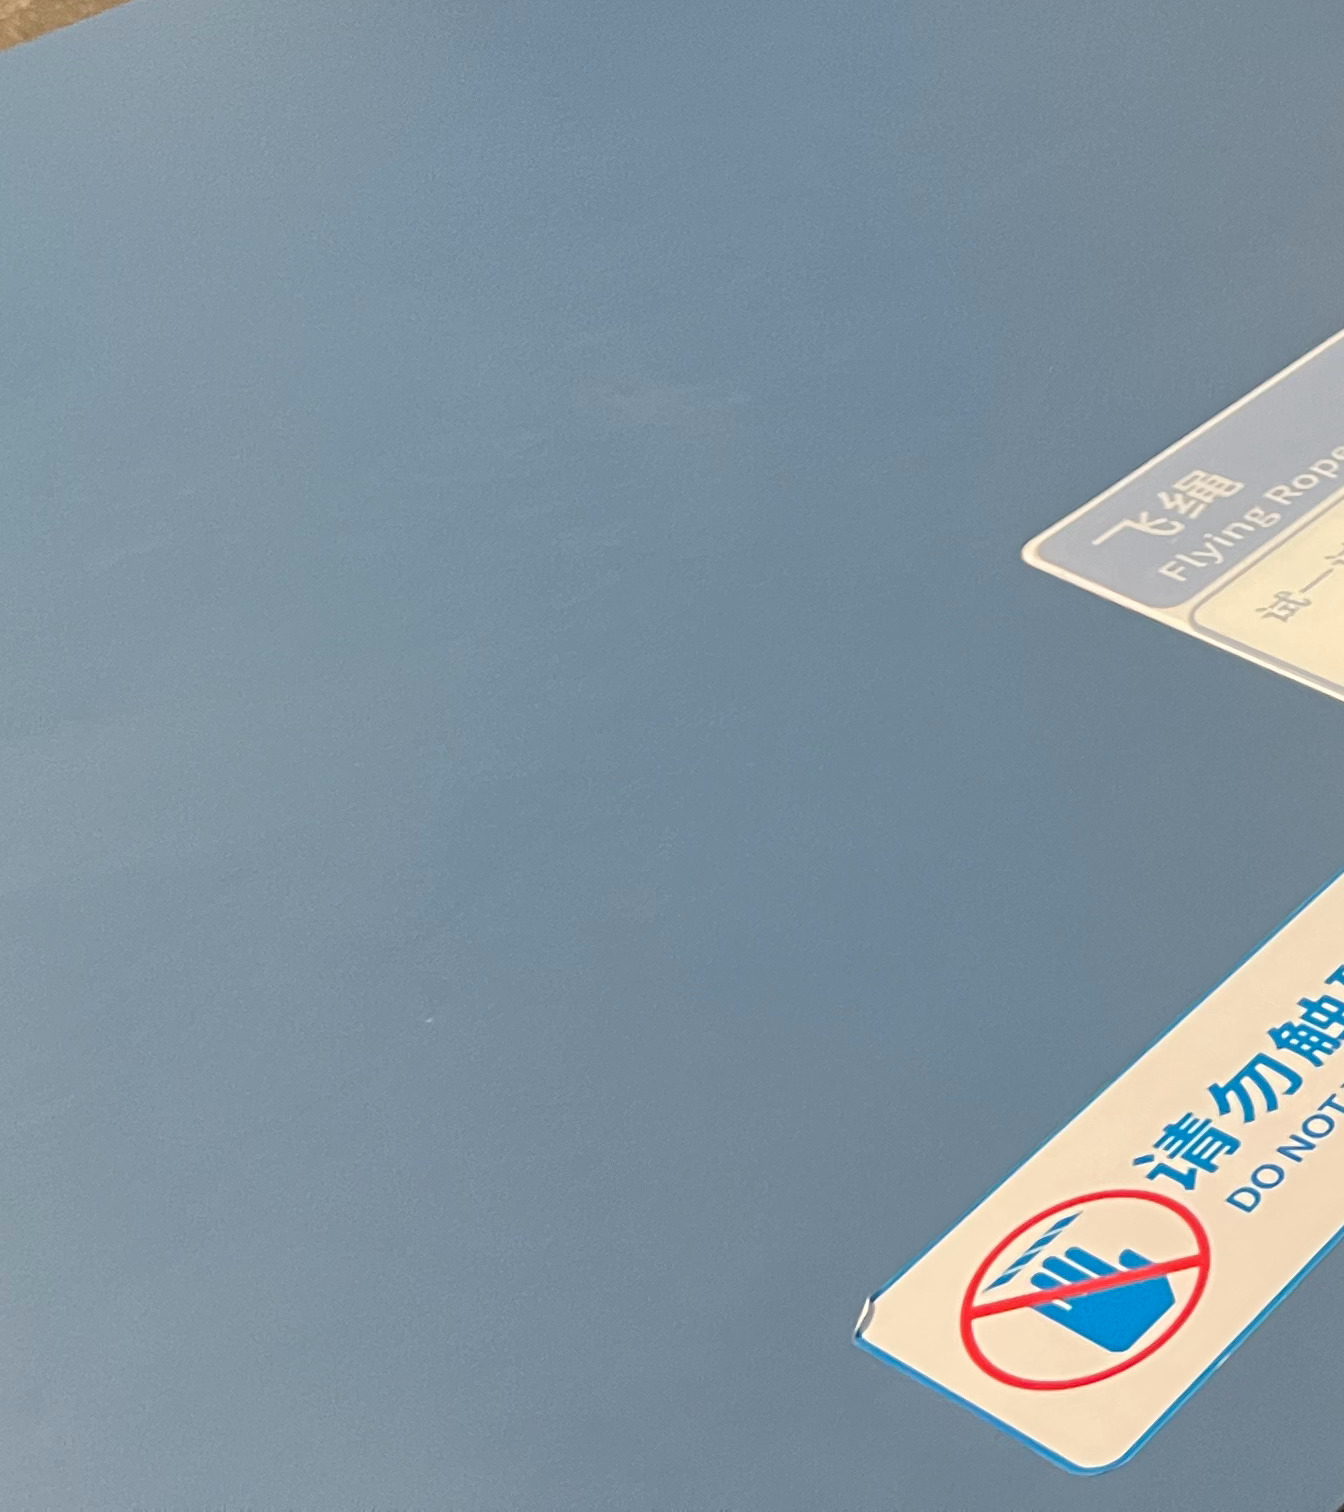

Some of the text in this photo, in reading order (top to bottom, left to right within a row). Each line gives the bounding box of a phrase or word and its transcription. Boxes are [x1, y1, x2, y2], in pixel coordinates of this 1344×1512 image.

[1091, 469, 1245, 545] 飞绳
[1157, 507, 1281, 581] Flying
[1225, 1164, 1285, 1213] DO
